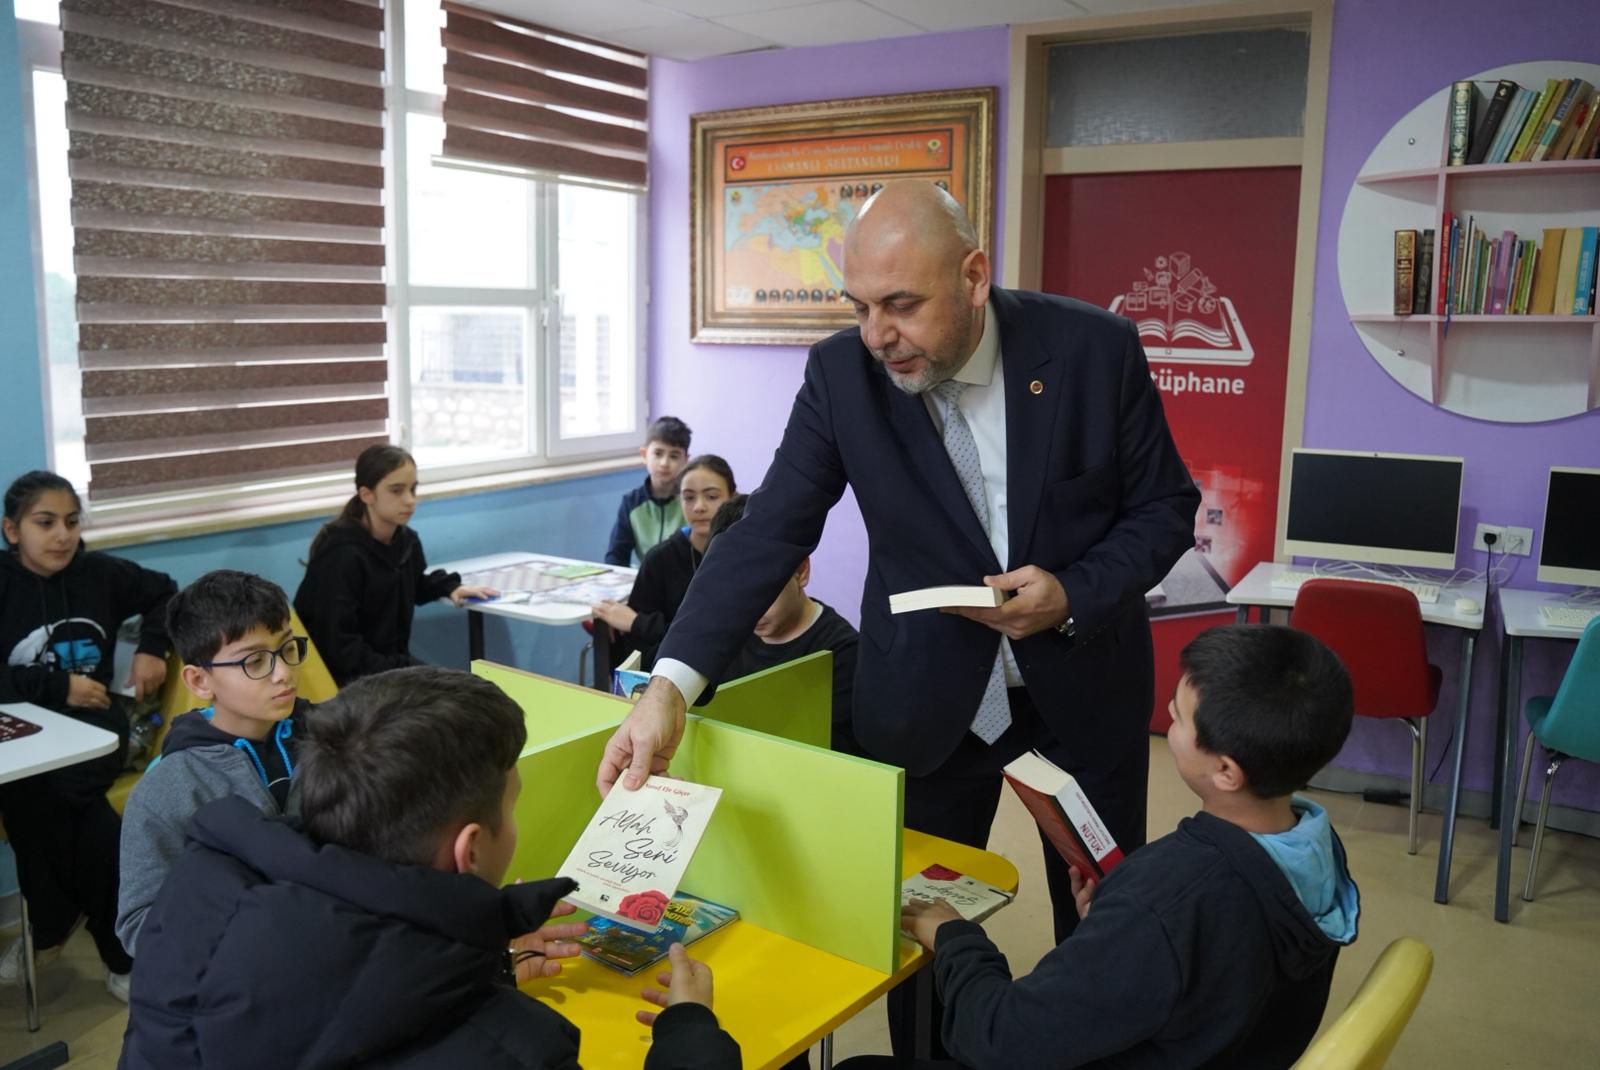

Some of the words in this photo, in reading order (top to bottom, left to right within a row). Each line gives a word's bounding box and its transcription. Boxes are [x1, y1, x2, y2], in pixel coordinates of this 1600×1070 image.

[598, 809, 657, 836] Allah
[624, 838, 679, 864] Seni
[1080, 823, 1104, 855] NUTUK
[587, 850, 657, 883] Seviyor
